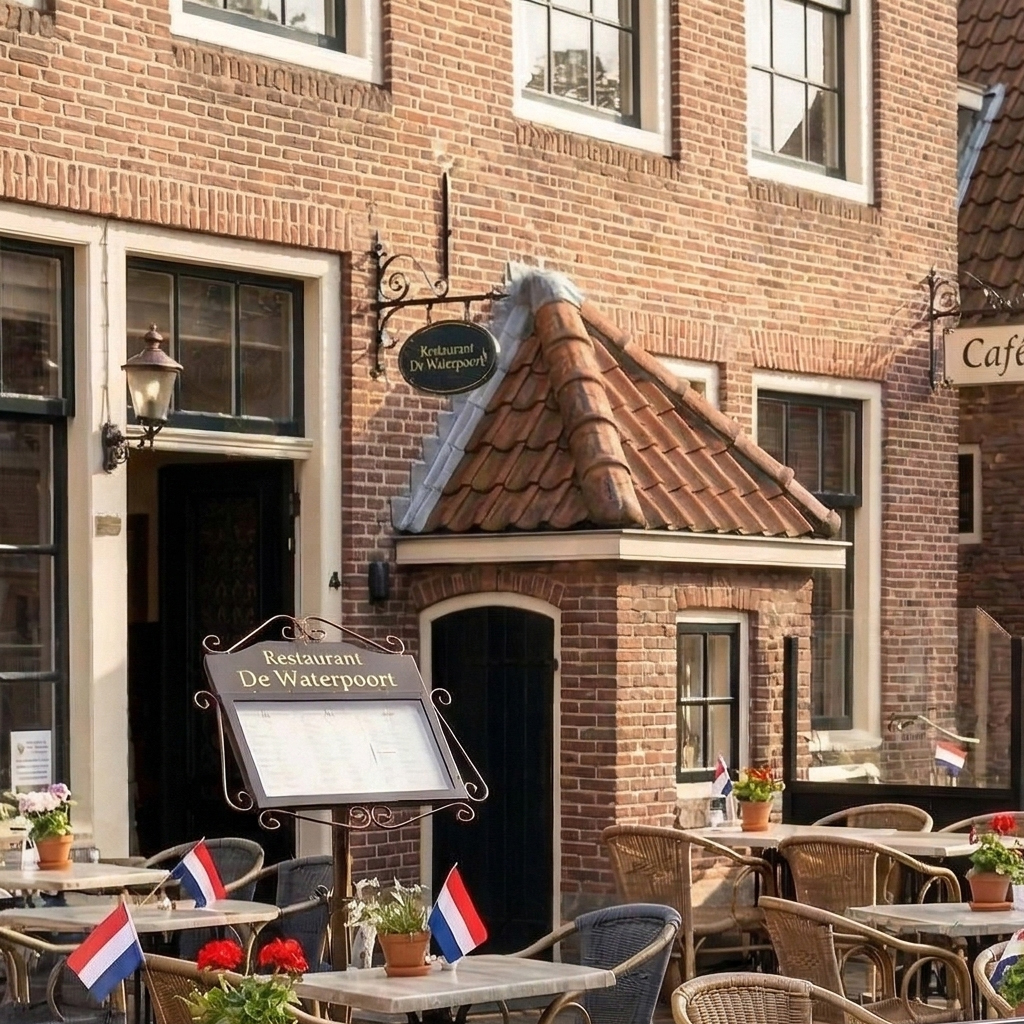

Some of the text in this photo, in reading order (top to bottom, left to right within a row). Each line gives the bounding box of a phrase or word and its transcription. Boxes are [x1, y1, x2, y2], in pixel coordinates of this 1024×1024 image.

[263, 650, 363, 666] Restaurant
[237, 669, 398, 691] De Waterpoort
